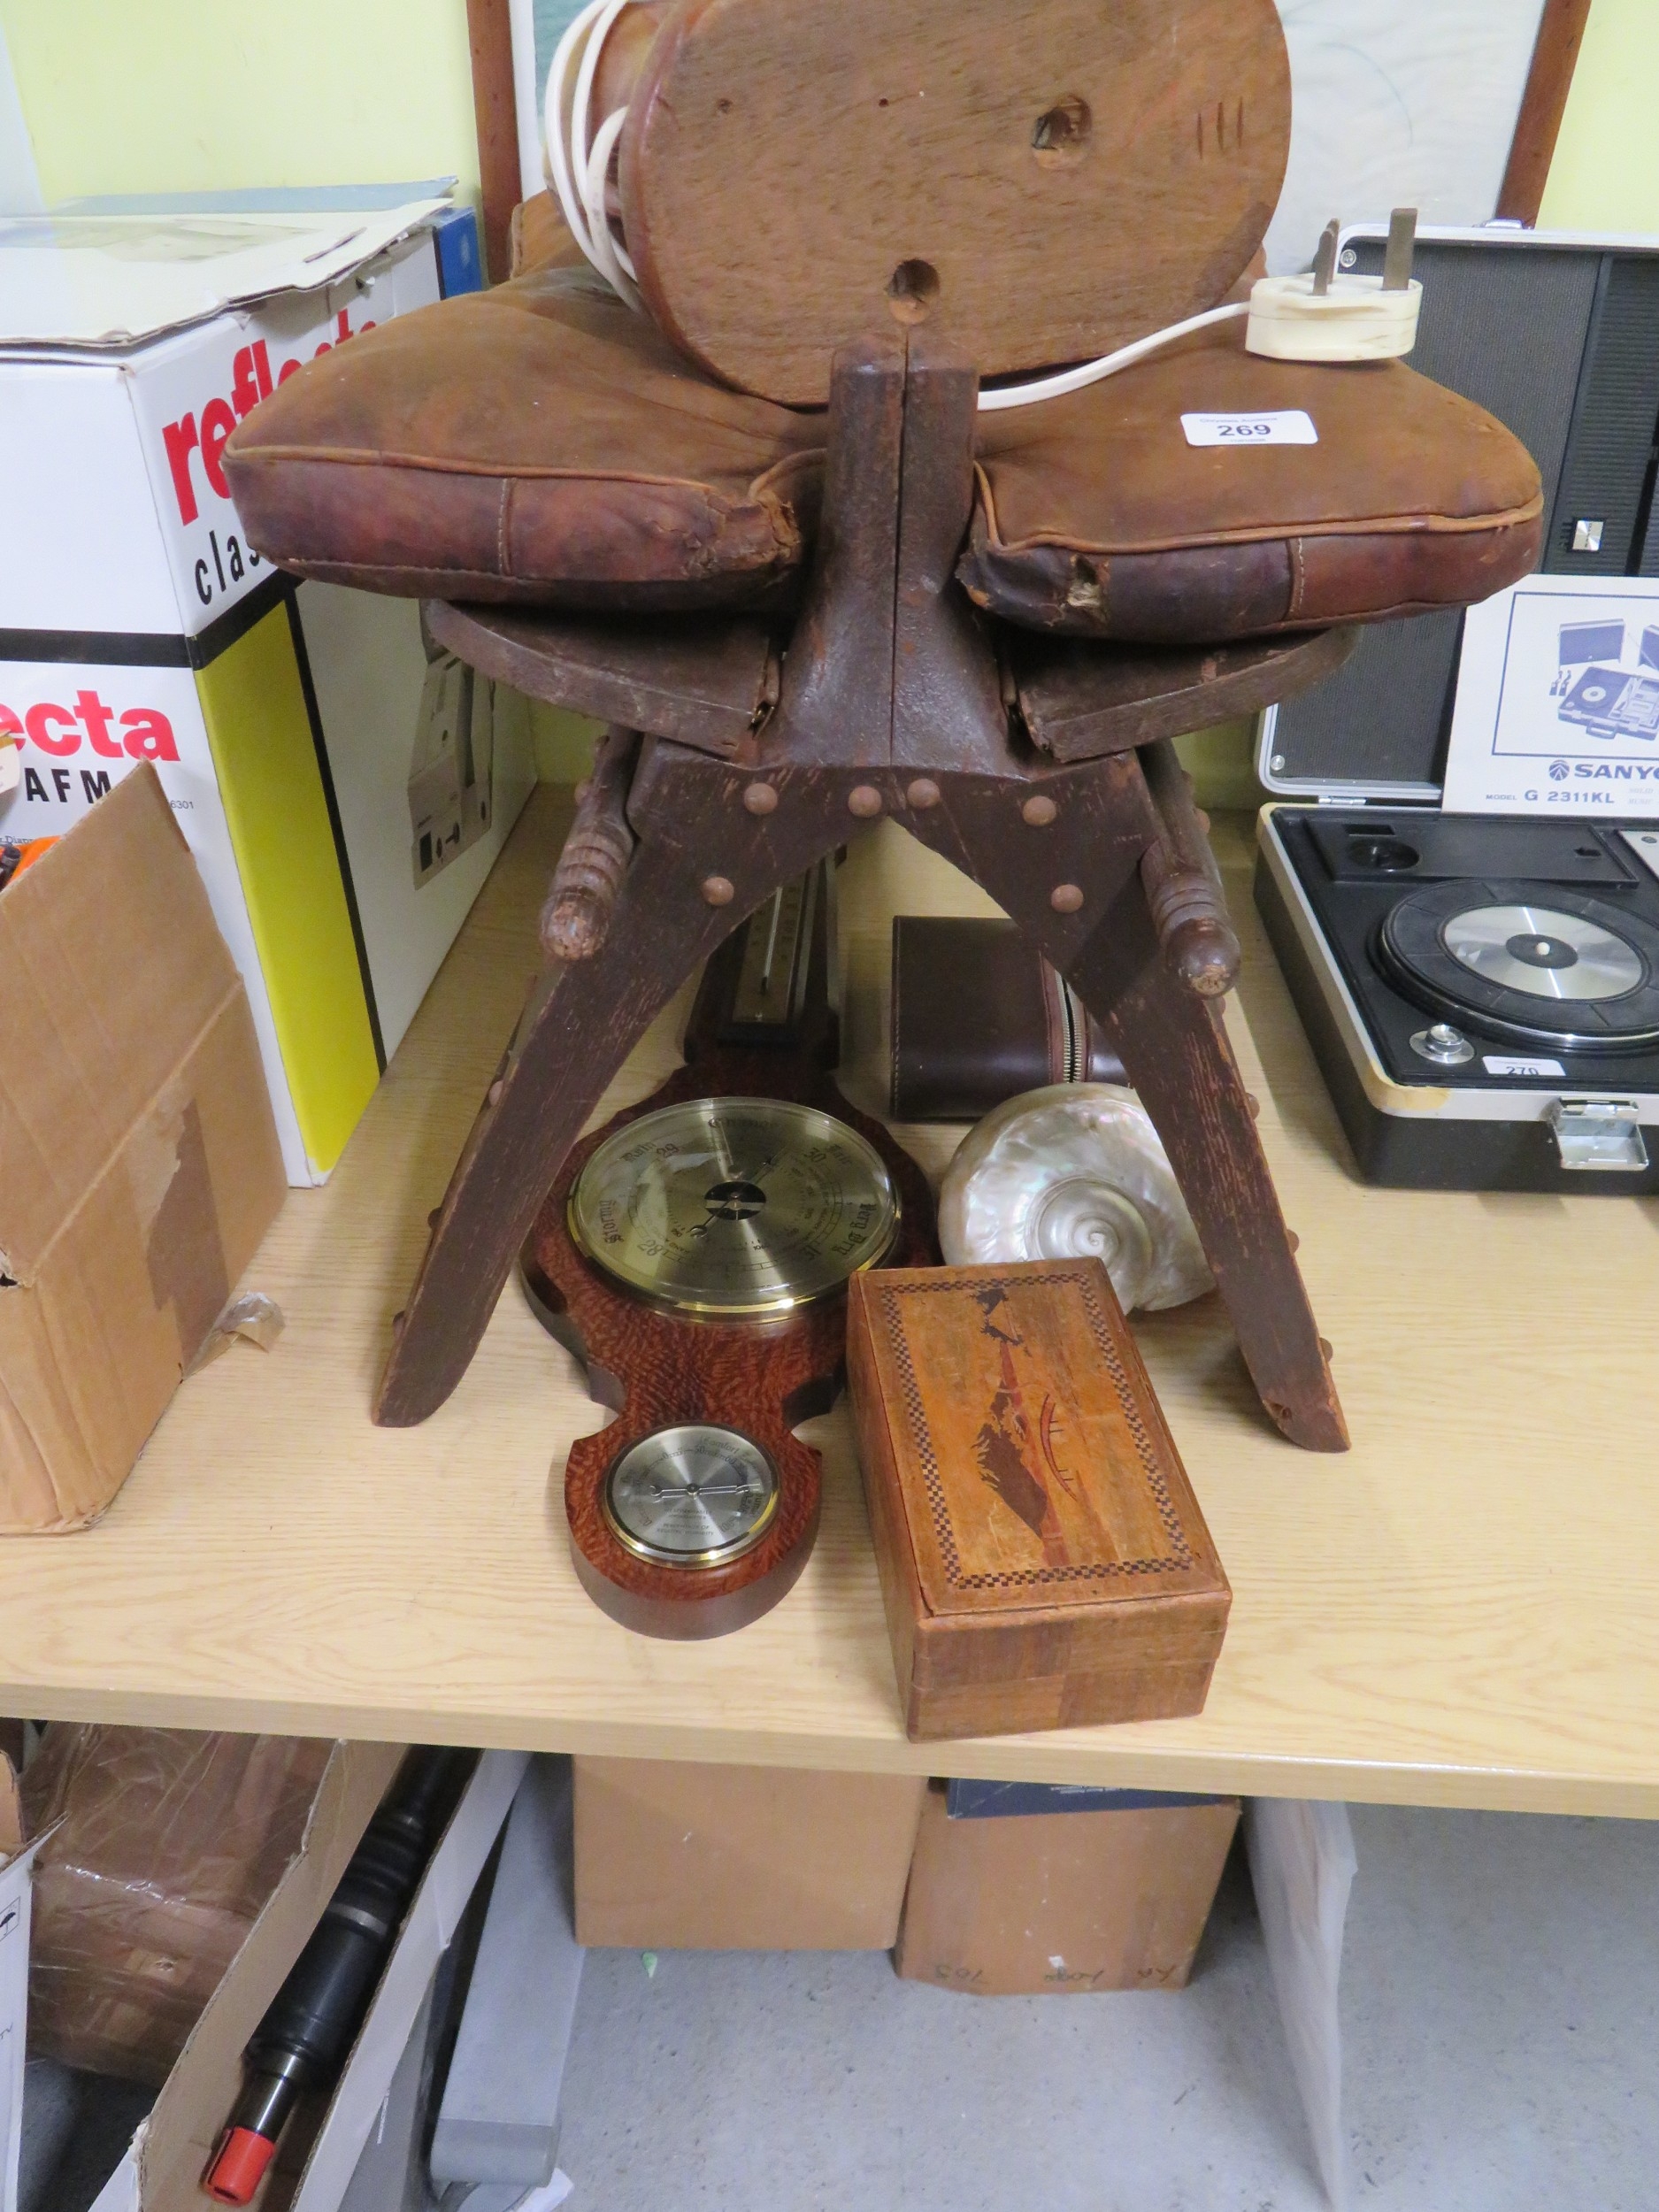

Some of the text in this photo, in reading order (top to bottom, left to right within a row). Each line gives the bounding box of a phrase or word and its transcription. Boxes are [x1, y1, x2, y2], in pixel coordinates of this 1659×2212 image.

[1216, 424, 1272, 437] 269
[1524, 788, 1539, 802] G
[1547, 790, 1616, 804] 2311KL
[803, 1147, 827, 1164] 30
[637, 1239, 664, 1256] 28
